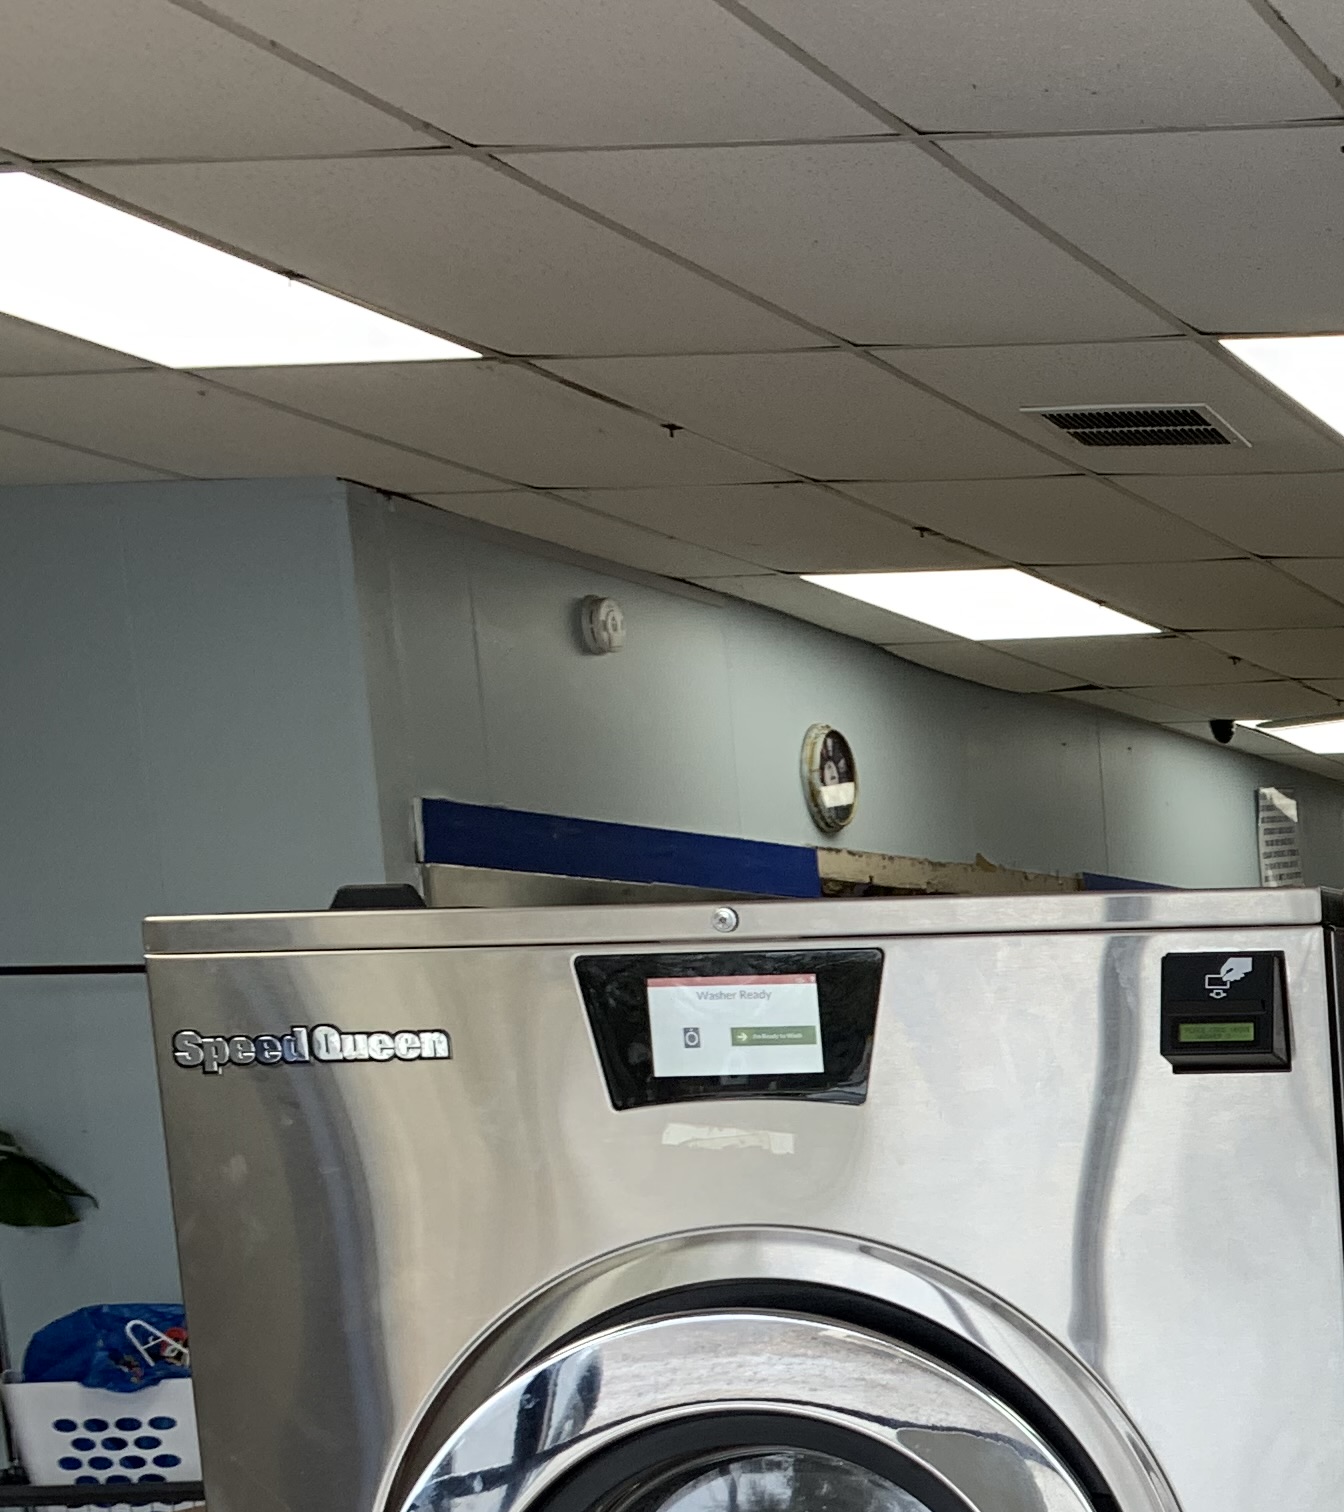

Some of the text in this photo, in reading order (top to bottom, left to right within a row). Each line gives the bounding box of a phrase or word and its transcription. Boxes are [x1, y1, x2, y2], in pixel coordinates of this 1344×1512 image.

[696, 989, 772, 1001] Washer Ready
[172, 1024, 452, 1074] Speed Queen
